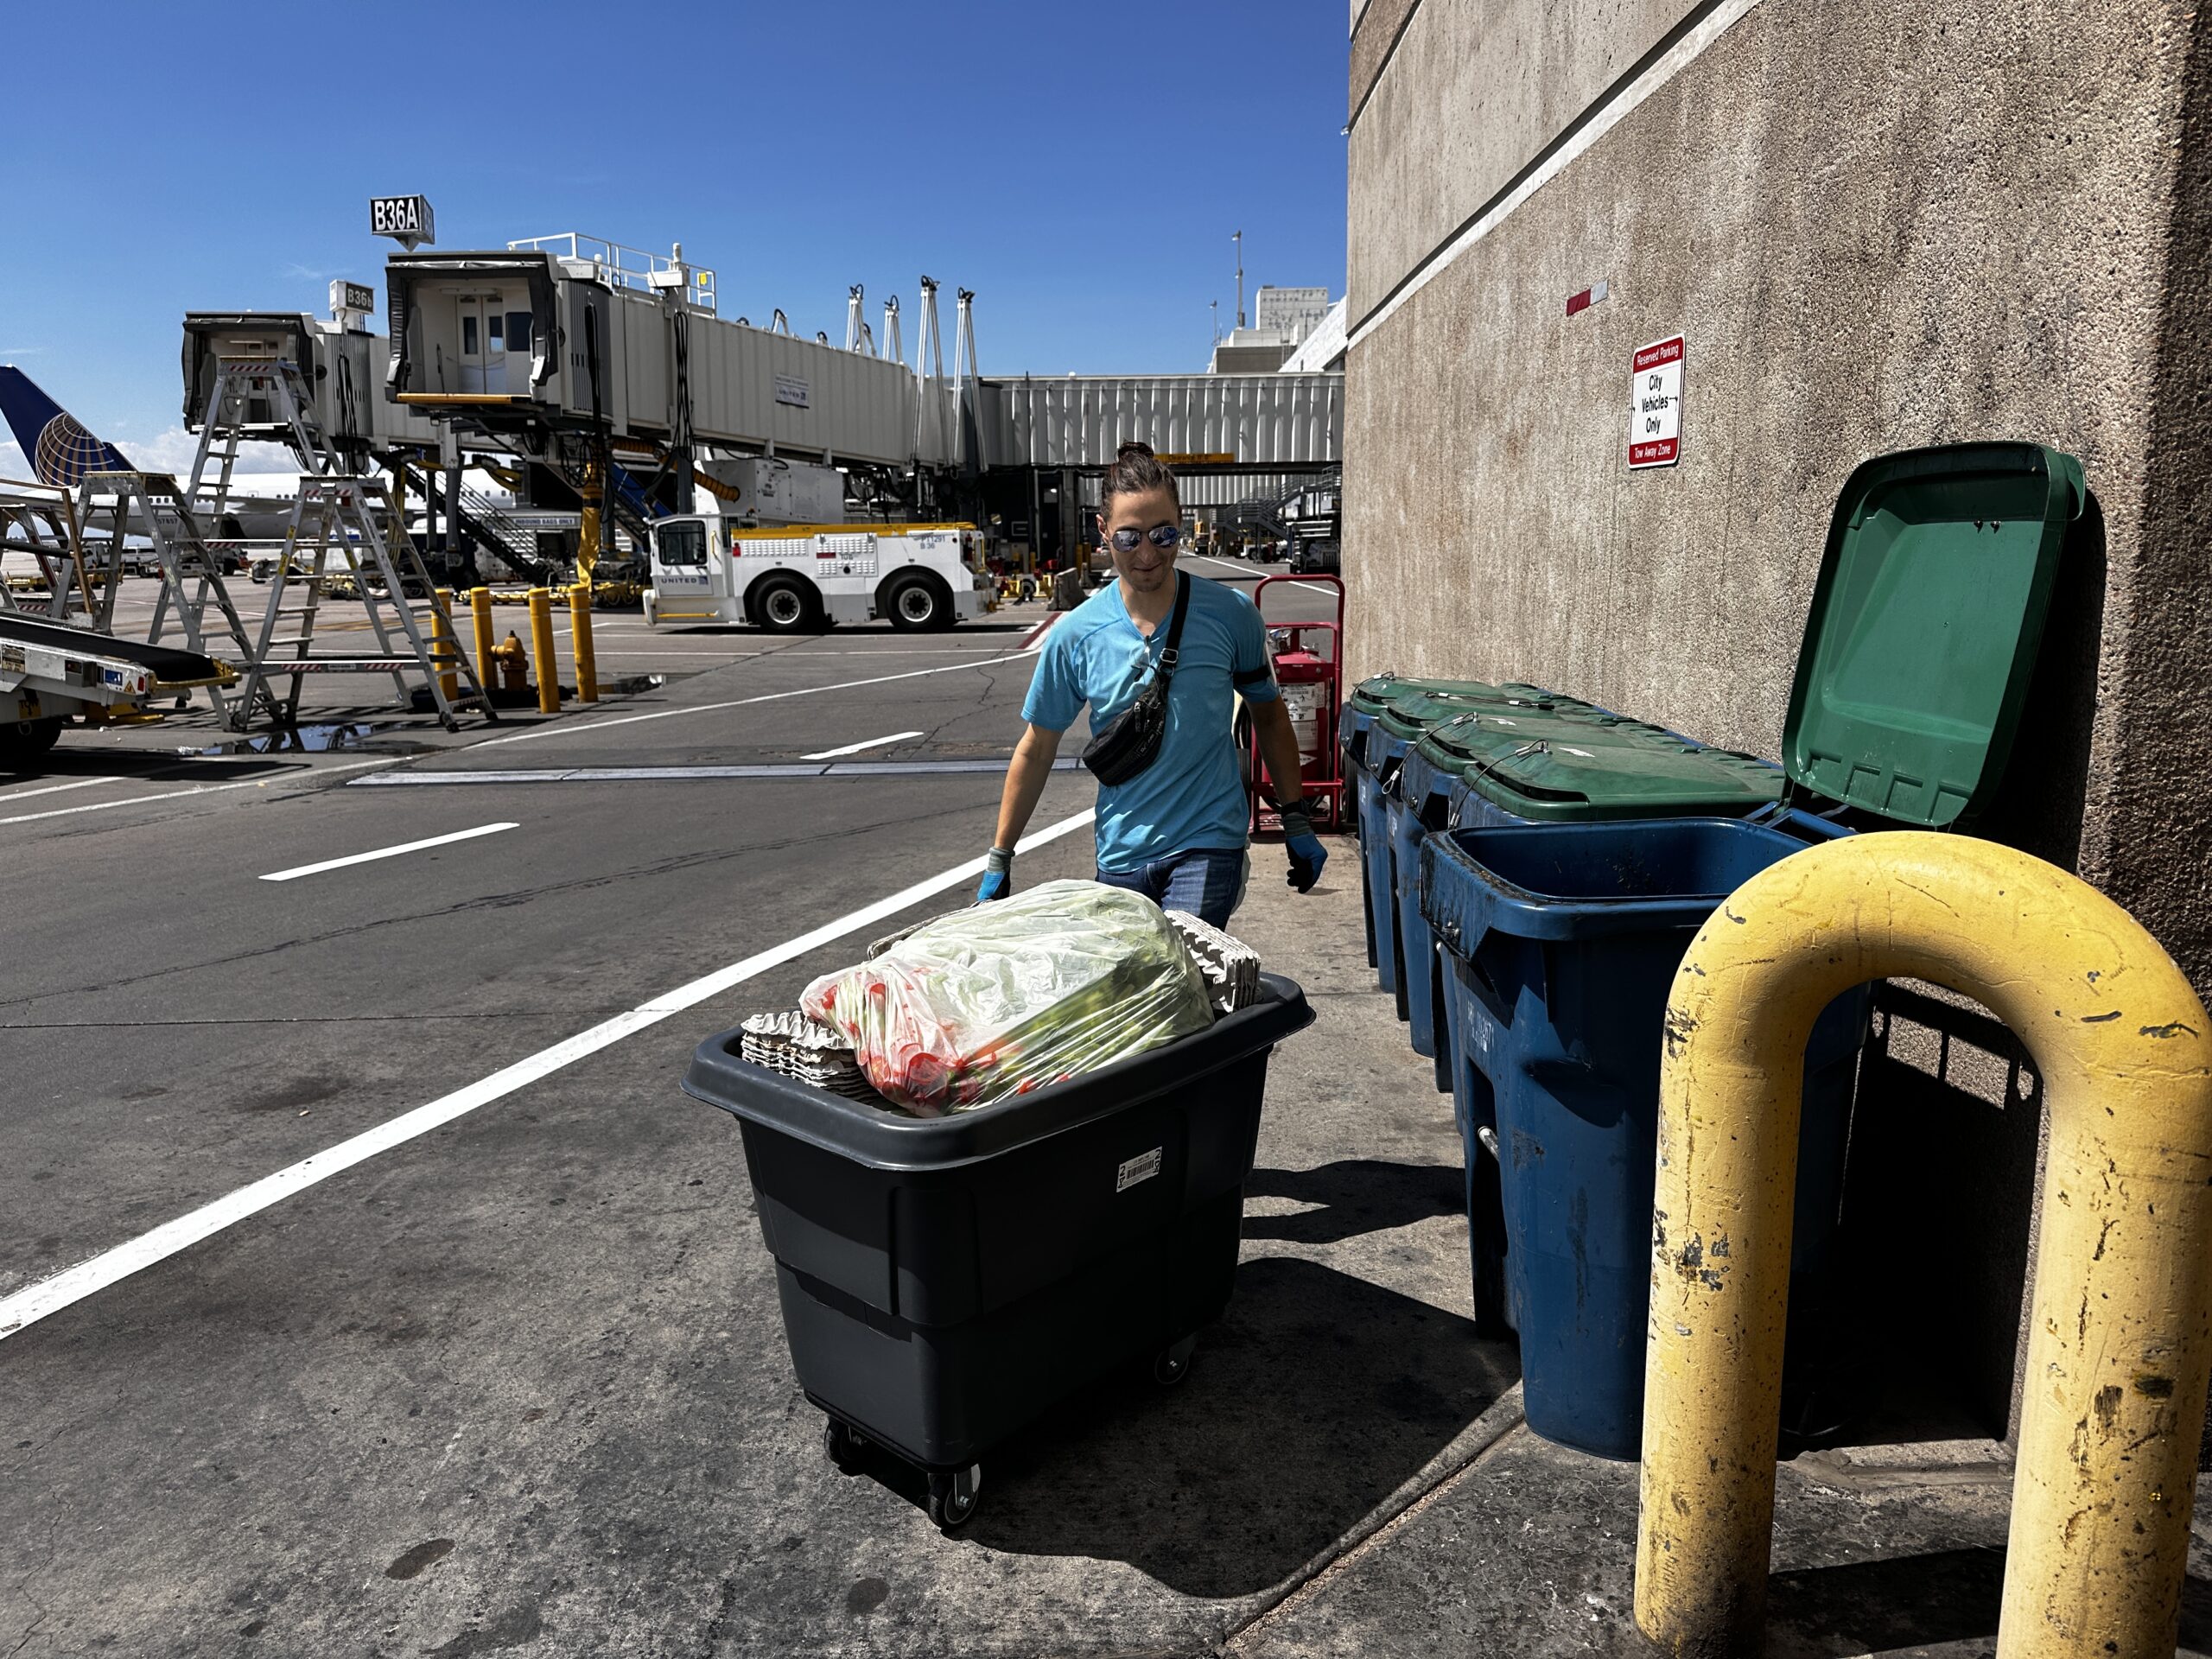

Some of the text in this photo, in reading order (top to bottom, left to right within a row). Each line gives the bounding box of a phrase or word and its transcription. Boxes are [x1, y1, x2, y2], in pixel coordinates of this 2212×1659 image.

[374, 198, 418, 231] B36A
[1637, 344, 1679, 366] Reserved Parking
[1649, 374, 1662, 391] City
[1642, 394, 1669, 413] Vehicles
[1645, 416, 1661, 435] Only
[1634, 443, 1671, 459] Tow Away Zone
[18, 698, 39, 709] TOW
